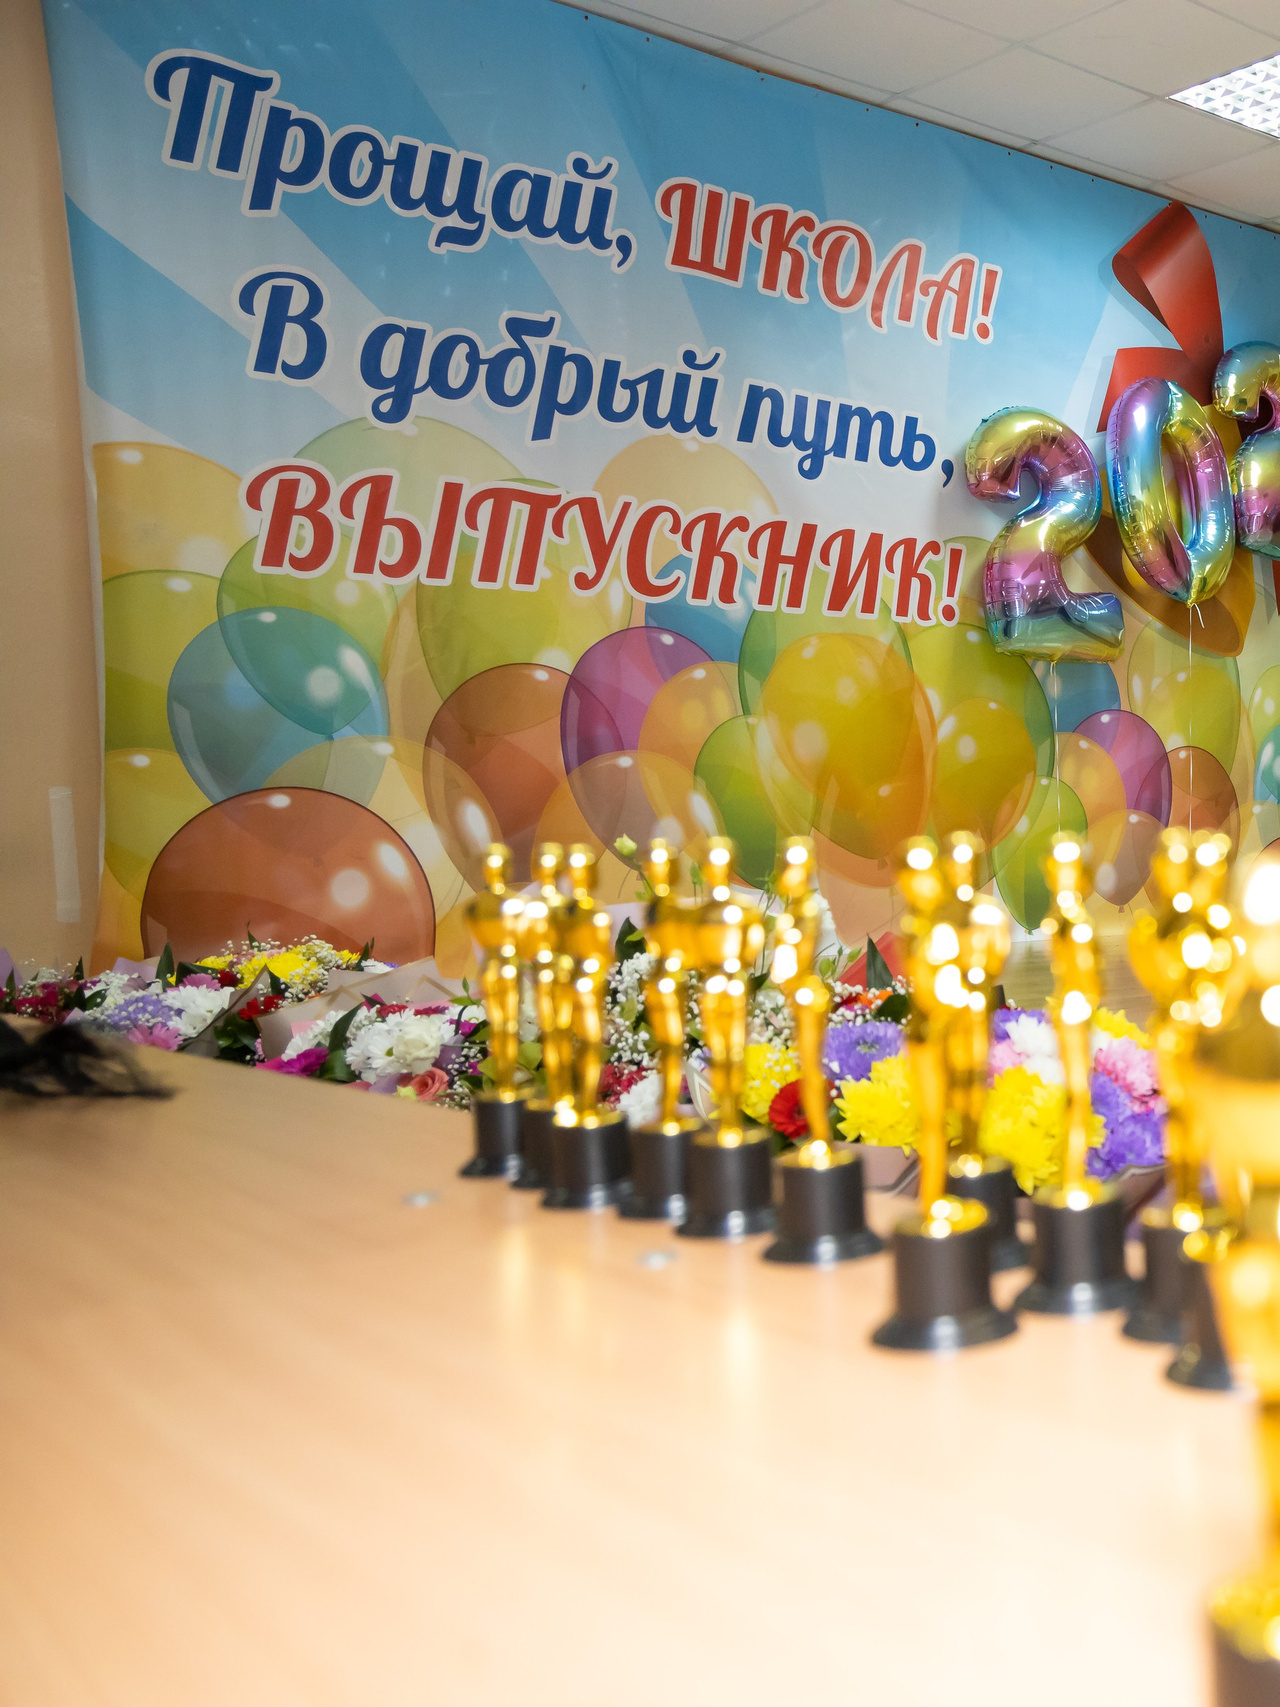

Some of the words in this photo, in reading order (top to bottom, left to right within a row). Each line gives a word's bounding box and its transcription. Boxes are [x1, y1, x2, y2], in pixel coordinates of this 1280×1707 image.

[152, 55, 632, 268] Прощай,
[660, 177, 1001, 341] ШКОЛА!
[239, 271, 327, 380] В
[360, 314, 719, 442] добрый
[737, 383, 953, 487] путь,
[246, 464, 964, 625] ВЫПУСКНИК!
